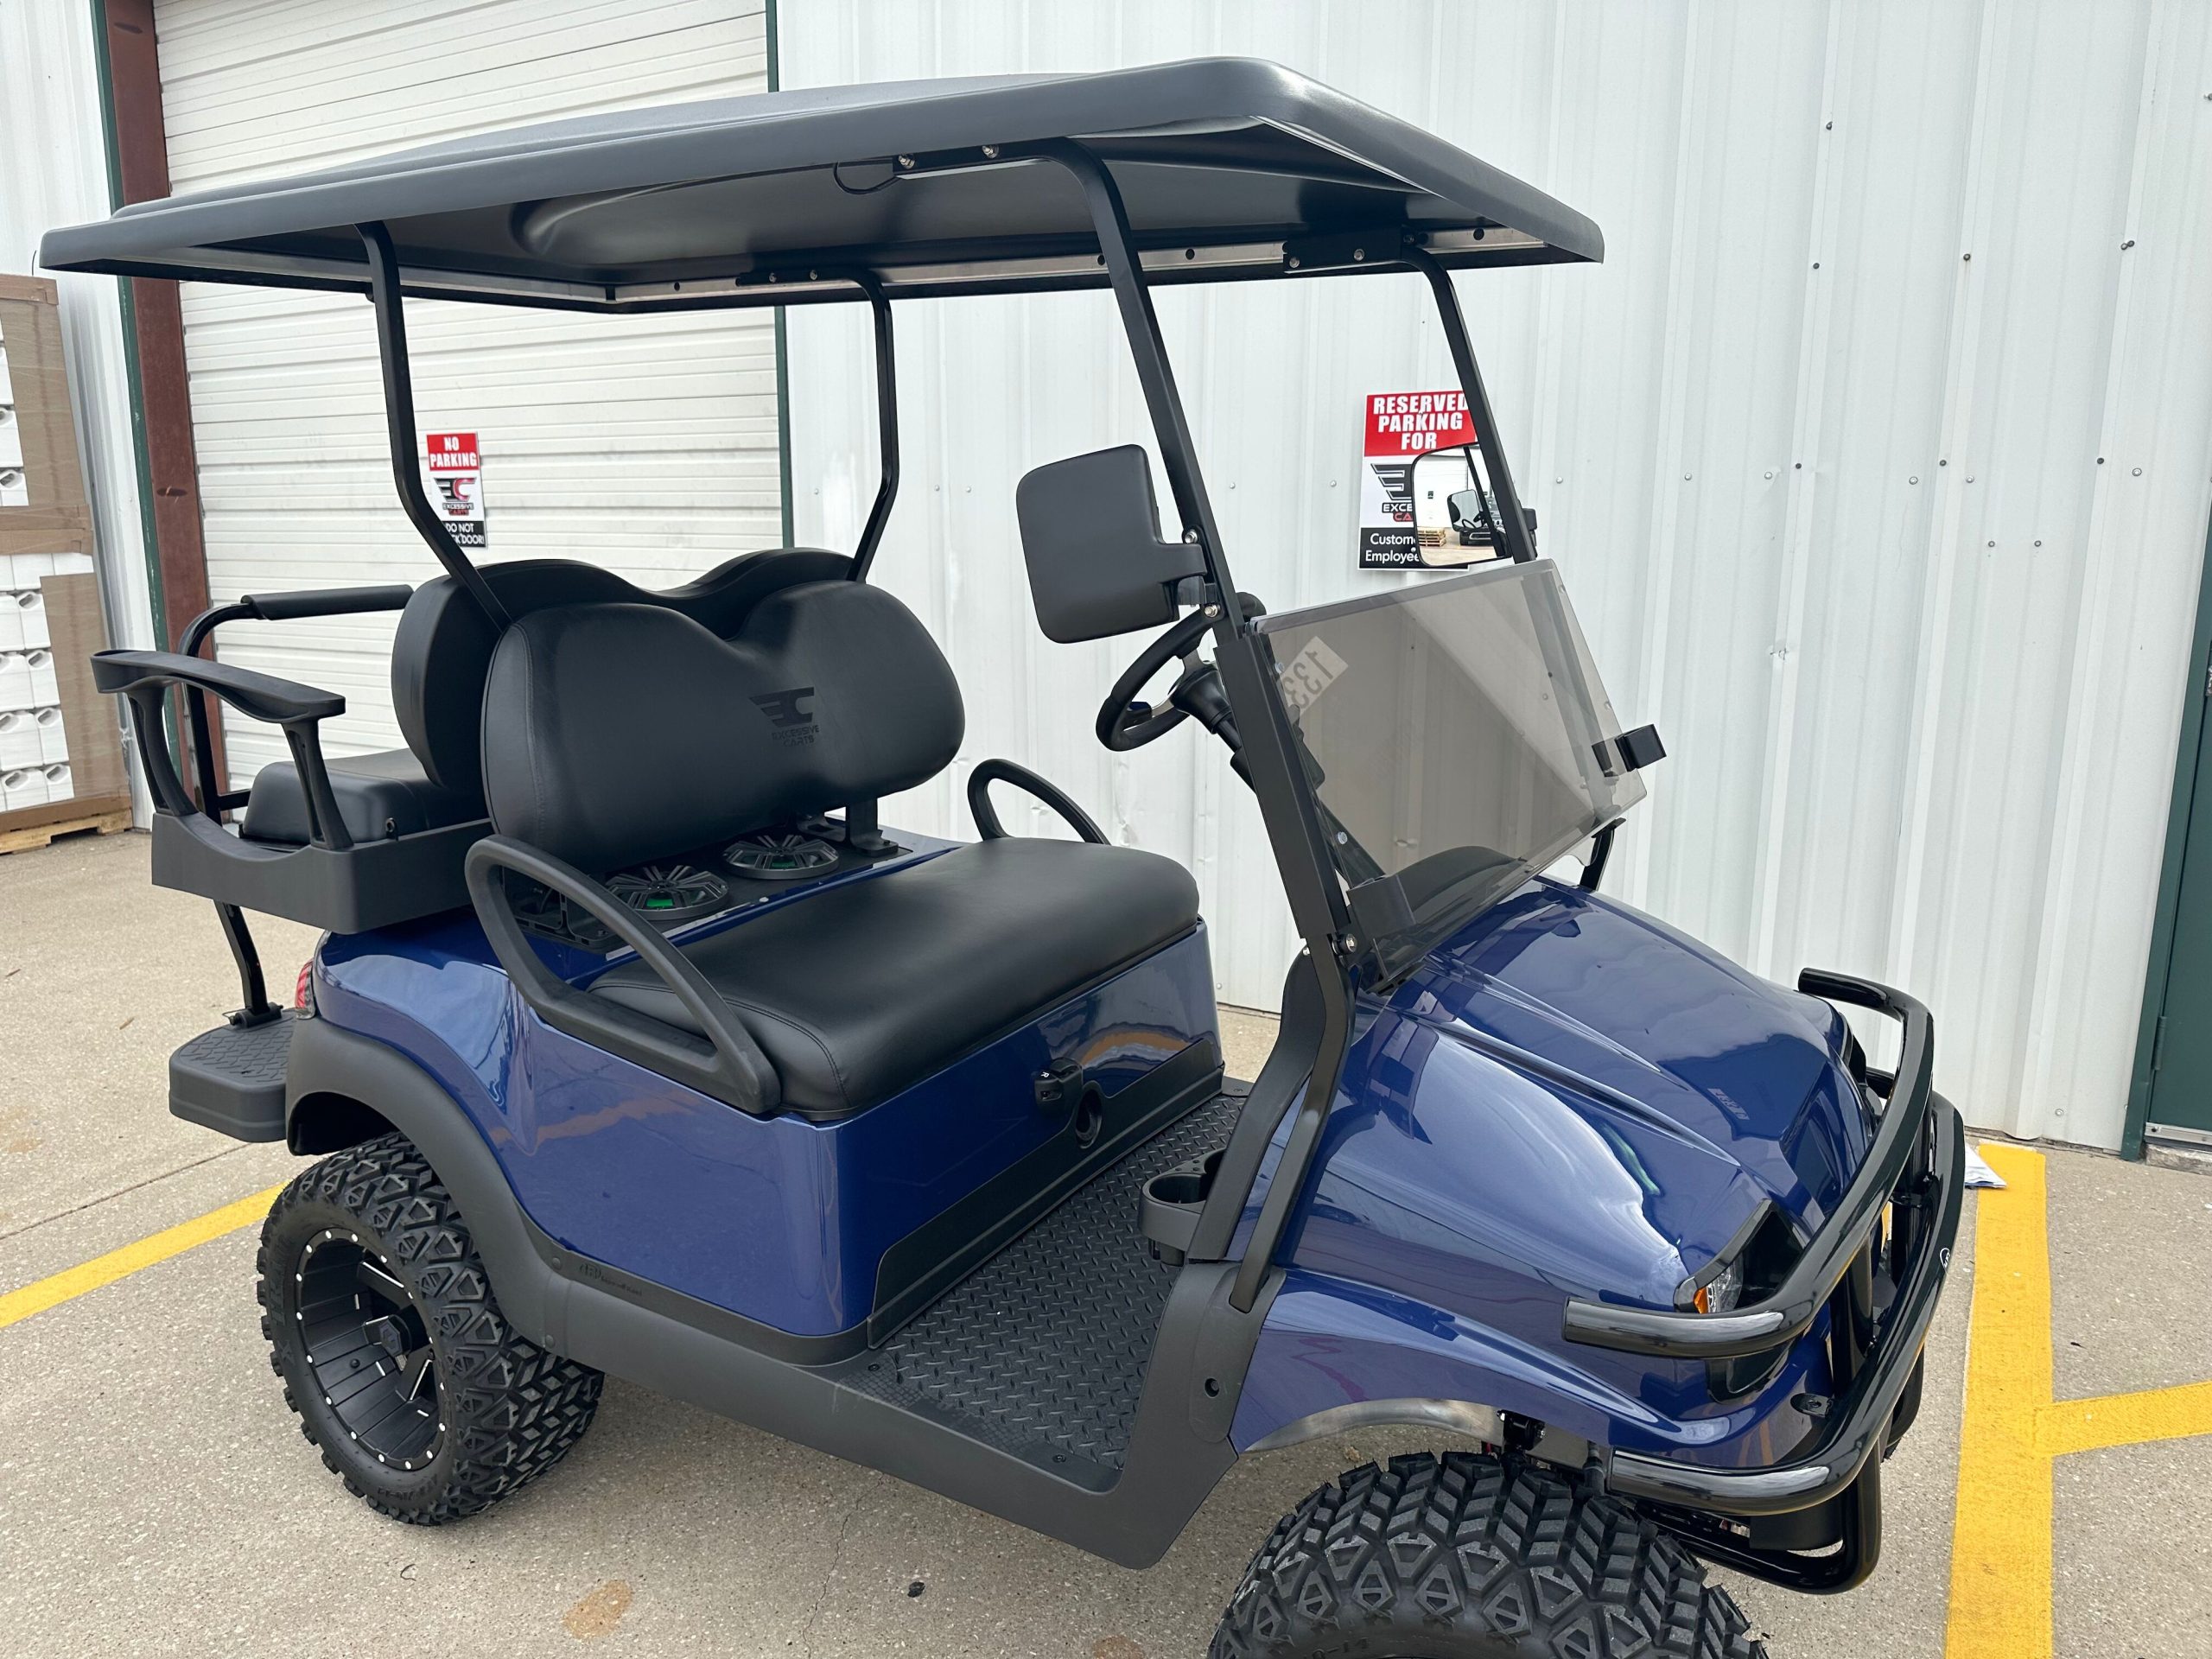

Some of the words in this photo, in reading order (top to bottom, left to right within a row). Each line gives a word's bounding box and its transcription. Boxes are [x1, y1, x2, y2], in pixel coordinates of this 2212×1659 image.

[1373, 393, 1469, 415] RESERVED
[1378, 412, 1463, 432] PARKING
[443, 436, 460, 451] NO
[1401, 432, 1437, 450] FOR
[429, 452, 477, 468] PARKING
[1382, 503, 1413, 512] EXCE
[1394, 512, 1413, 521] CA
[446, 522, 458, 533] DO
[458, 522, 474, 533] NOT
